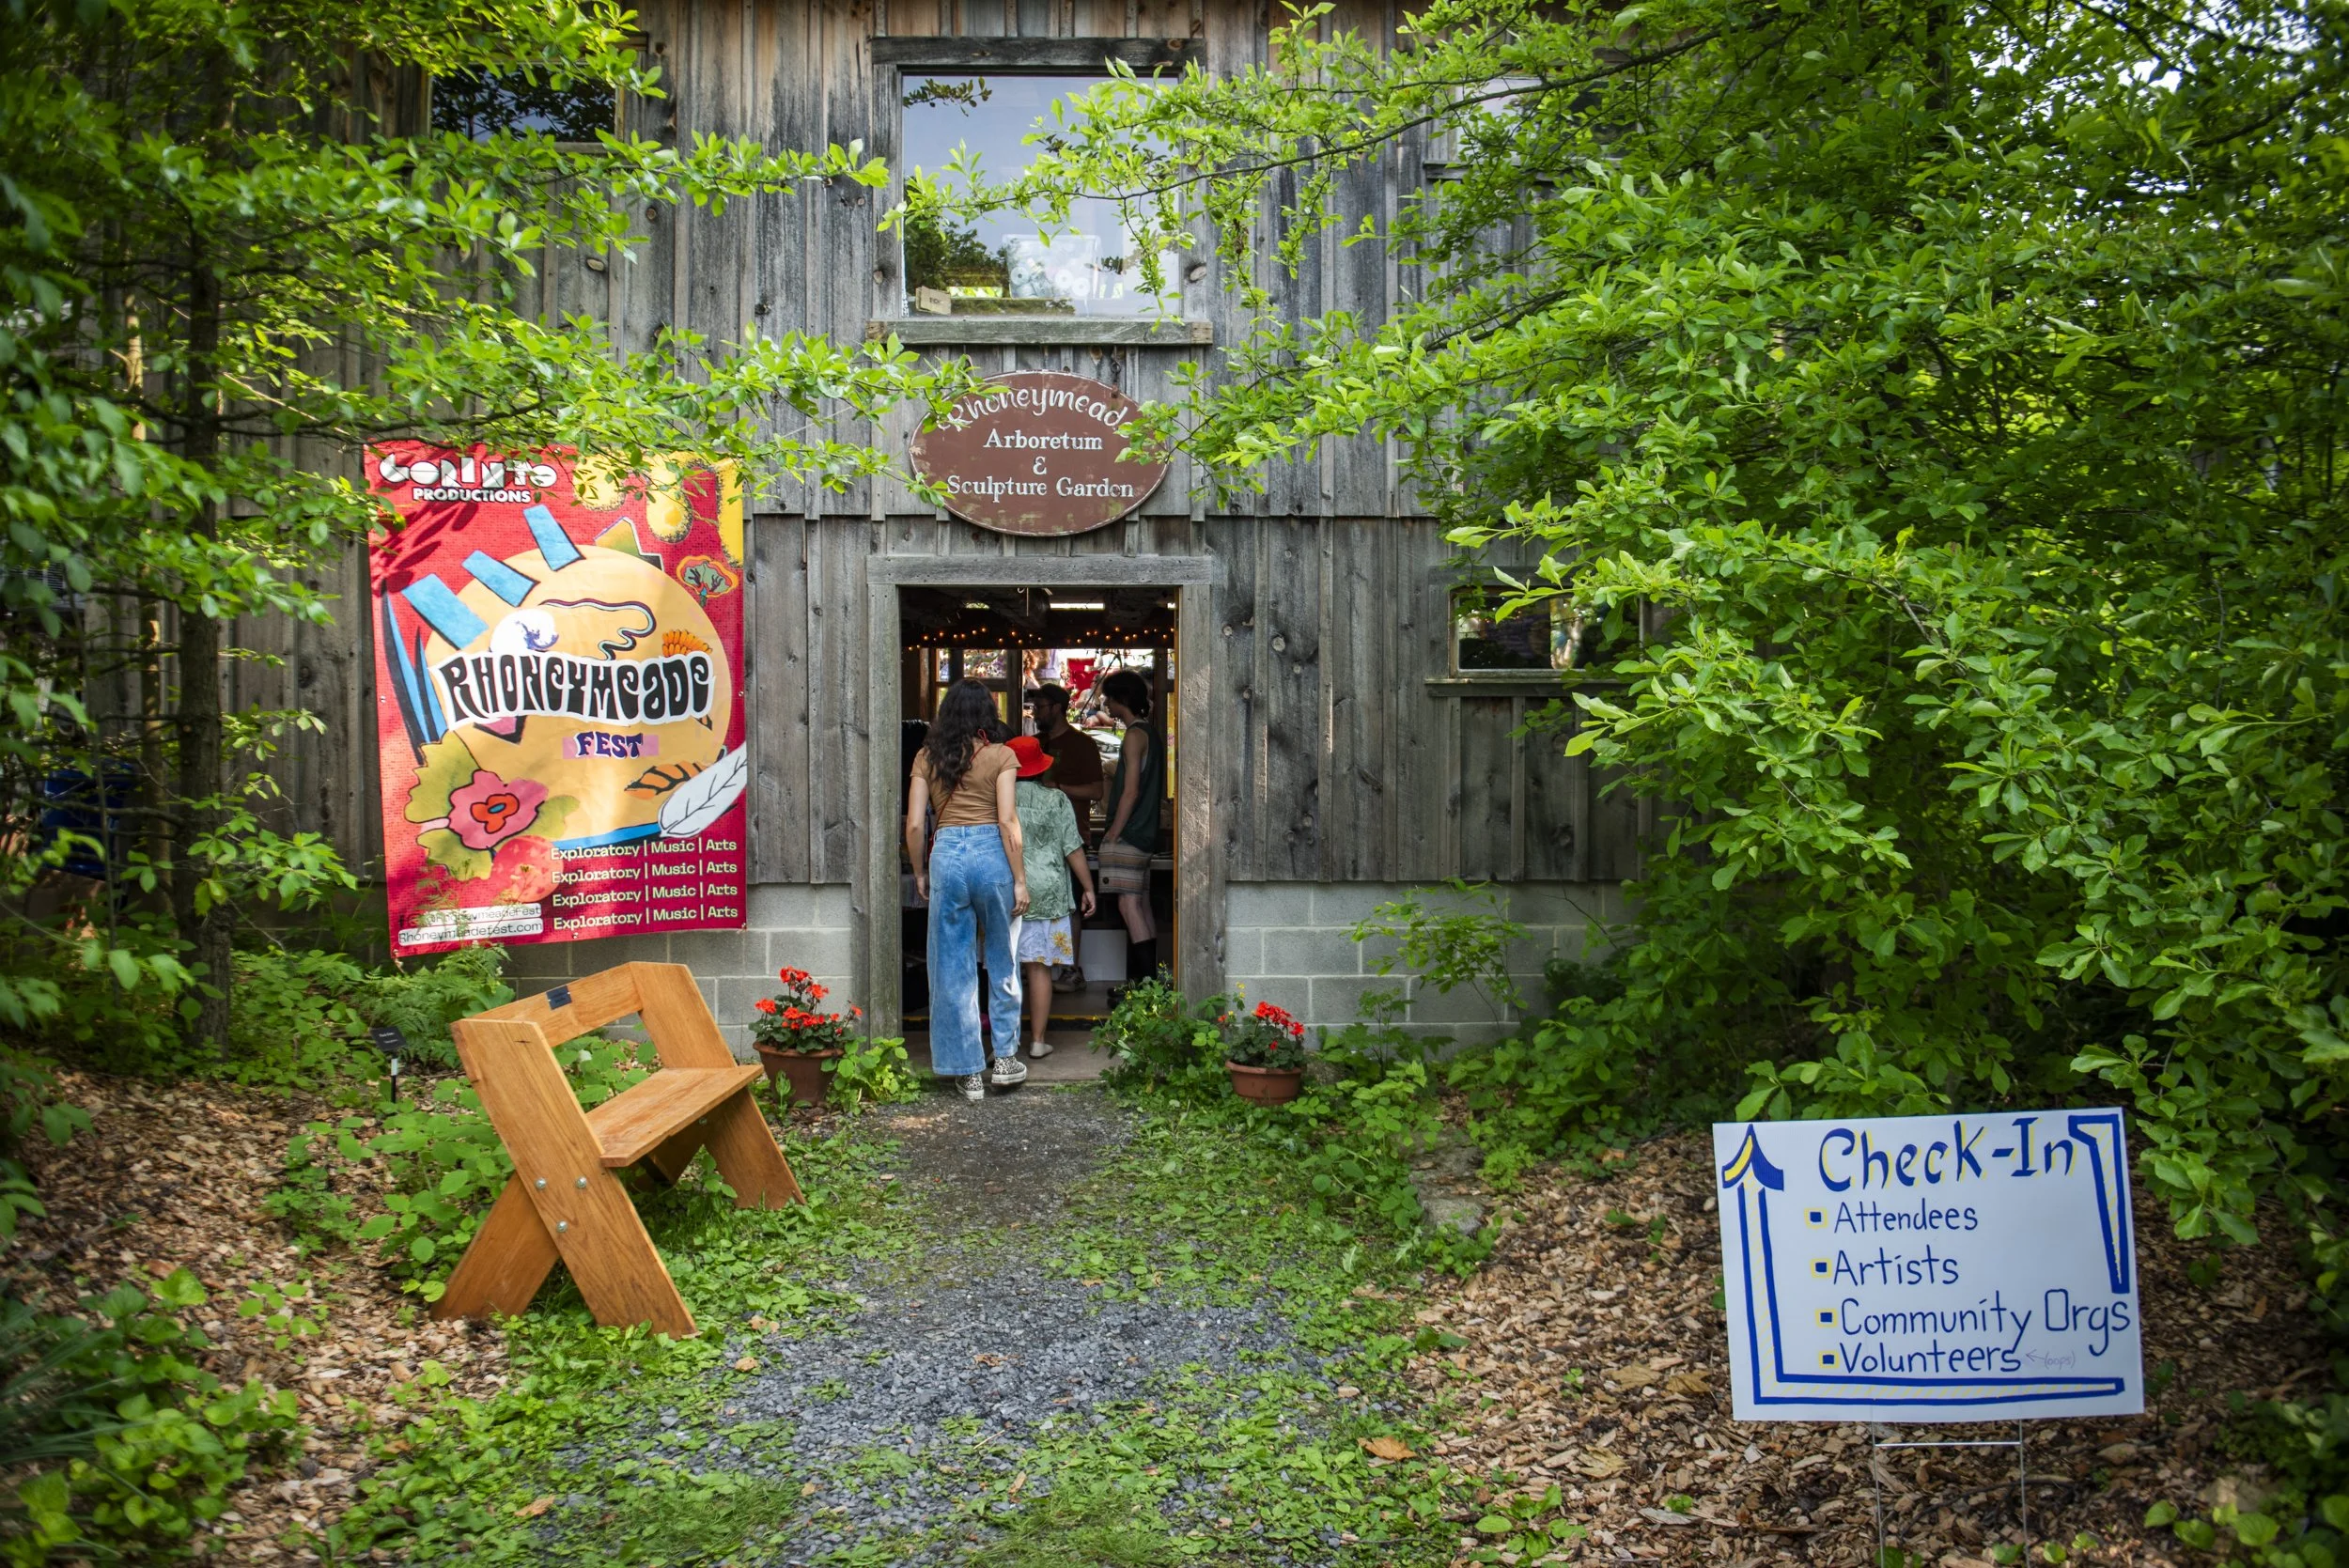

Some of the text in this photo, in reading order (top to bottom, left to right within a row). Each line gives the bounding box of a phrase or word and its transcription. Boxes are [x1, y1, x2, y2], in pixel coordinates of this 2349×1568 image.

[983, 427, 1103, 450] Arboretum
[412, 487, 532, 503] PRODUCTIONS
[946, 474, 1134, 504] Sculpture Garden
[574, 731, 644, 759] FEST
[551, 844, 640, 862] Exploratory
[651, 839, 694, 854] Music
[706, 839, 738, 851] Arts
[552, 866, 641, 885] Exploratory
[651, 862, 695, 876] Music
[707, 861, 738, 874] Arts
[552, 890, 642, 908] Exploratory
[652, 885, 696, 898] Music
[707, 883, 739, 895] Arts
[553, 912, 643, 931] Exploratory
[653, 907, 697, 922] Music
[708, 906, 739, 919] Arts
[398, 922, 542, 943] Rhoneymadefest.com
[1819, 1116, 2075, 1192] Check-In
[1834, 1197, 1979, 1234] Attendees
[1833, 1244, 1959, 1286] Artists
[1841, 1288, 2130, 1357] Community Orgs
[1840, 1339, 2021, 1374] Volunteers
